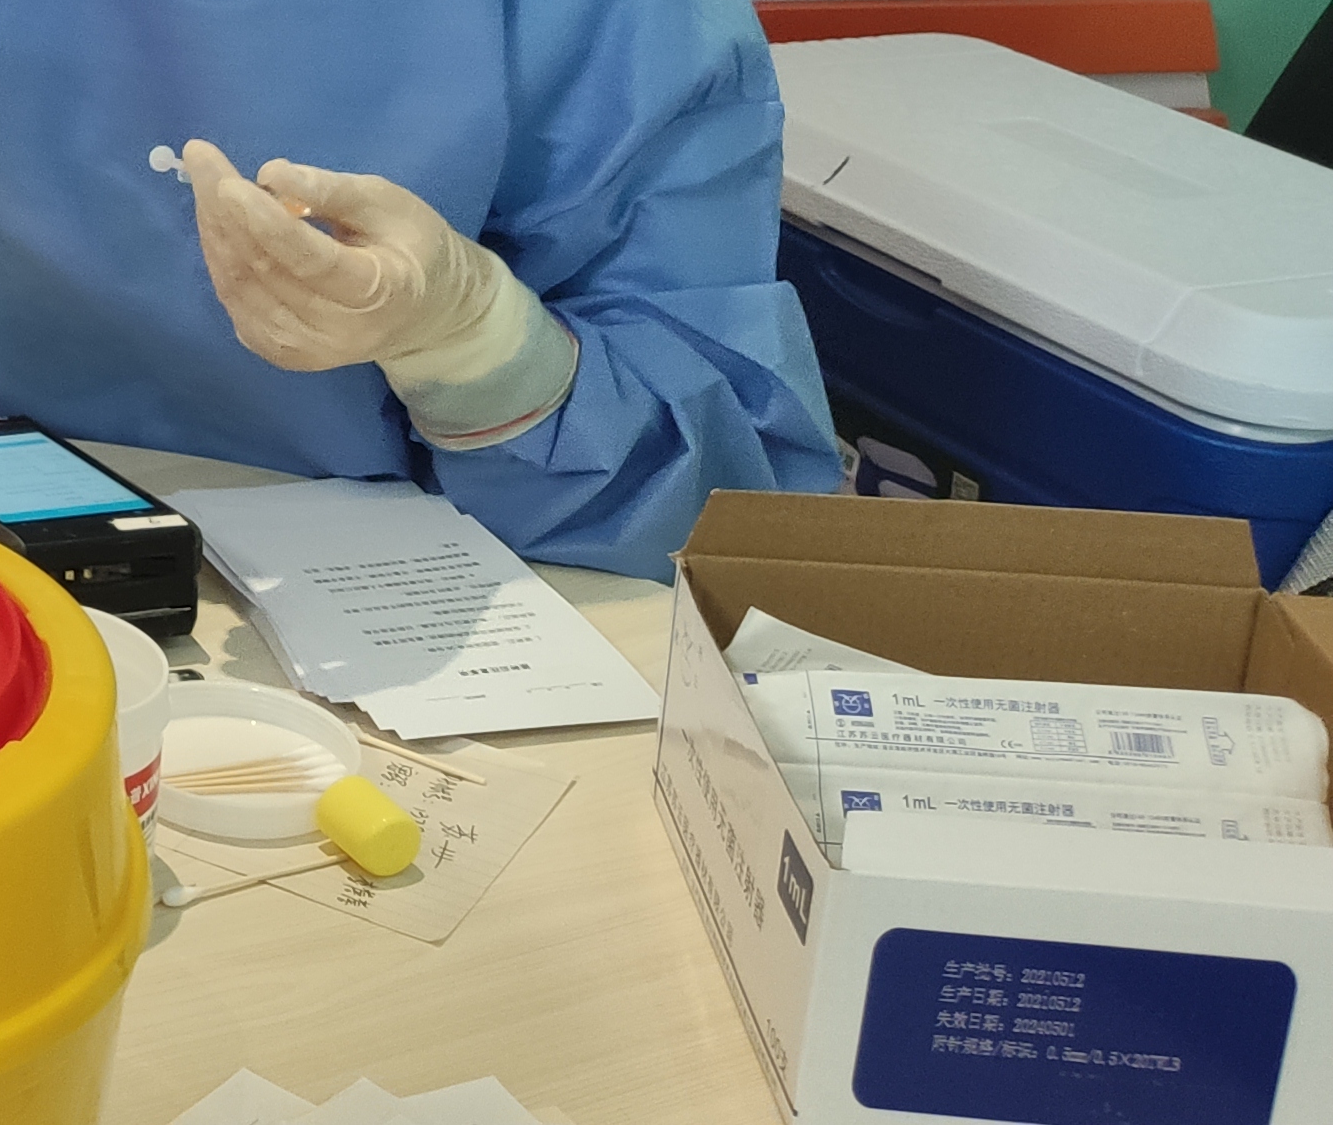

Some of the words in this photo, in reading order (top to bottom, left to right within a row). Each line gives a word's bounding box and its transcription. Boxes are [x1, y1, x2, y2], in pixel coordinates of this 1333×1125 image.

[933, 696, 1061, 715] 一次性使用无菌注射器
[944, 798, 1075, 817] 一次性使用无菌注射器
[780, 853, 809, 927] 1mL
[1020, 968, 1085, 988] 20210512
[1016, 992, 1081, 1012] 20210512
